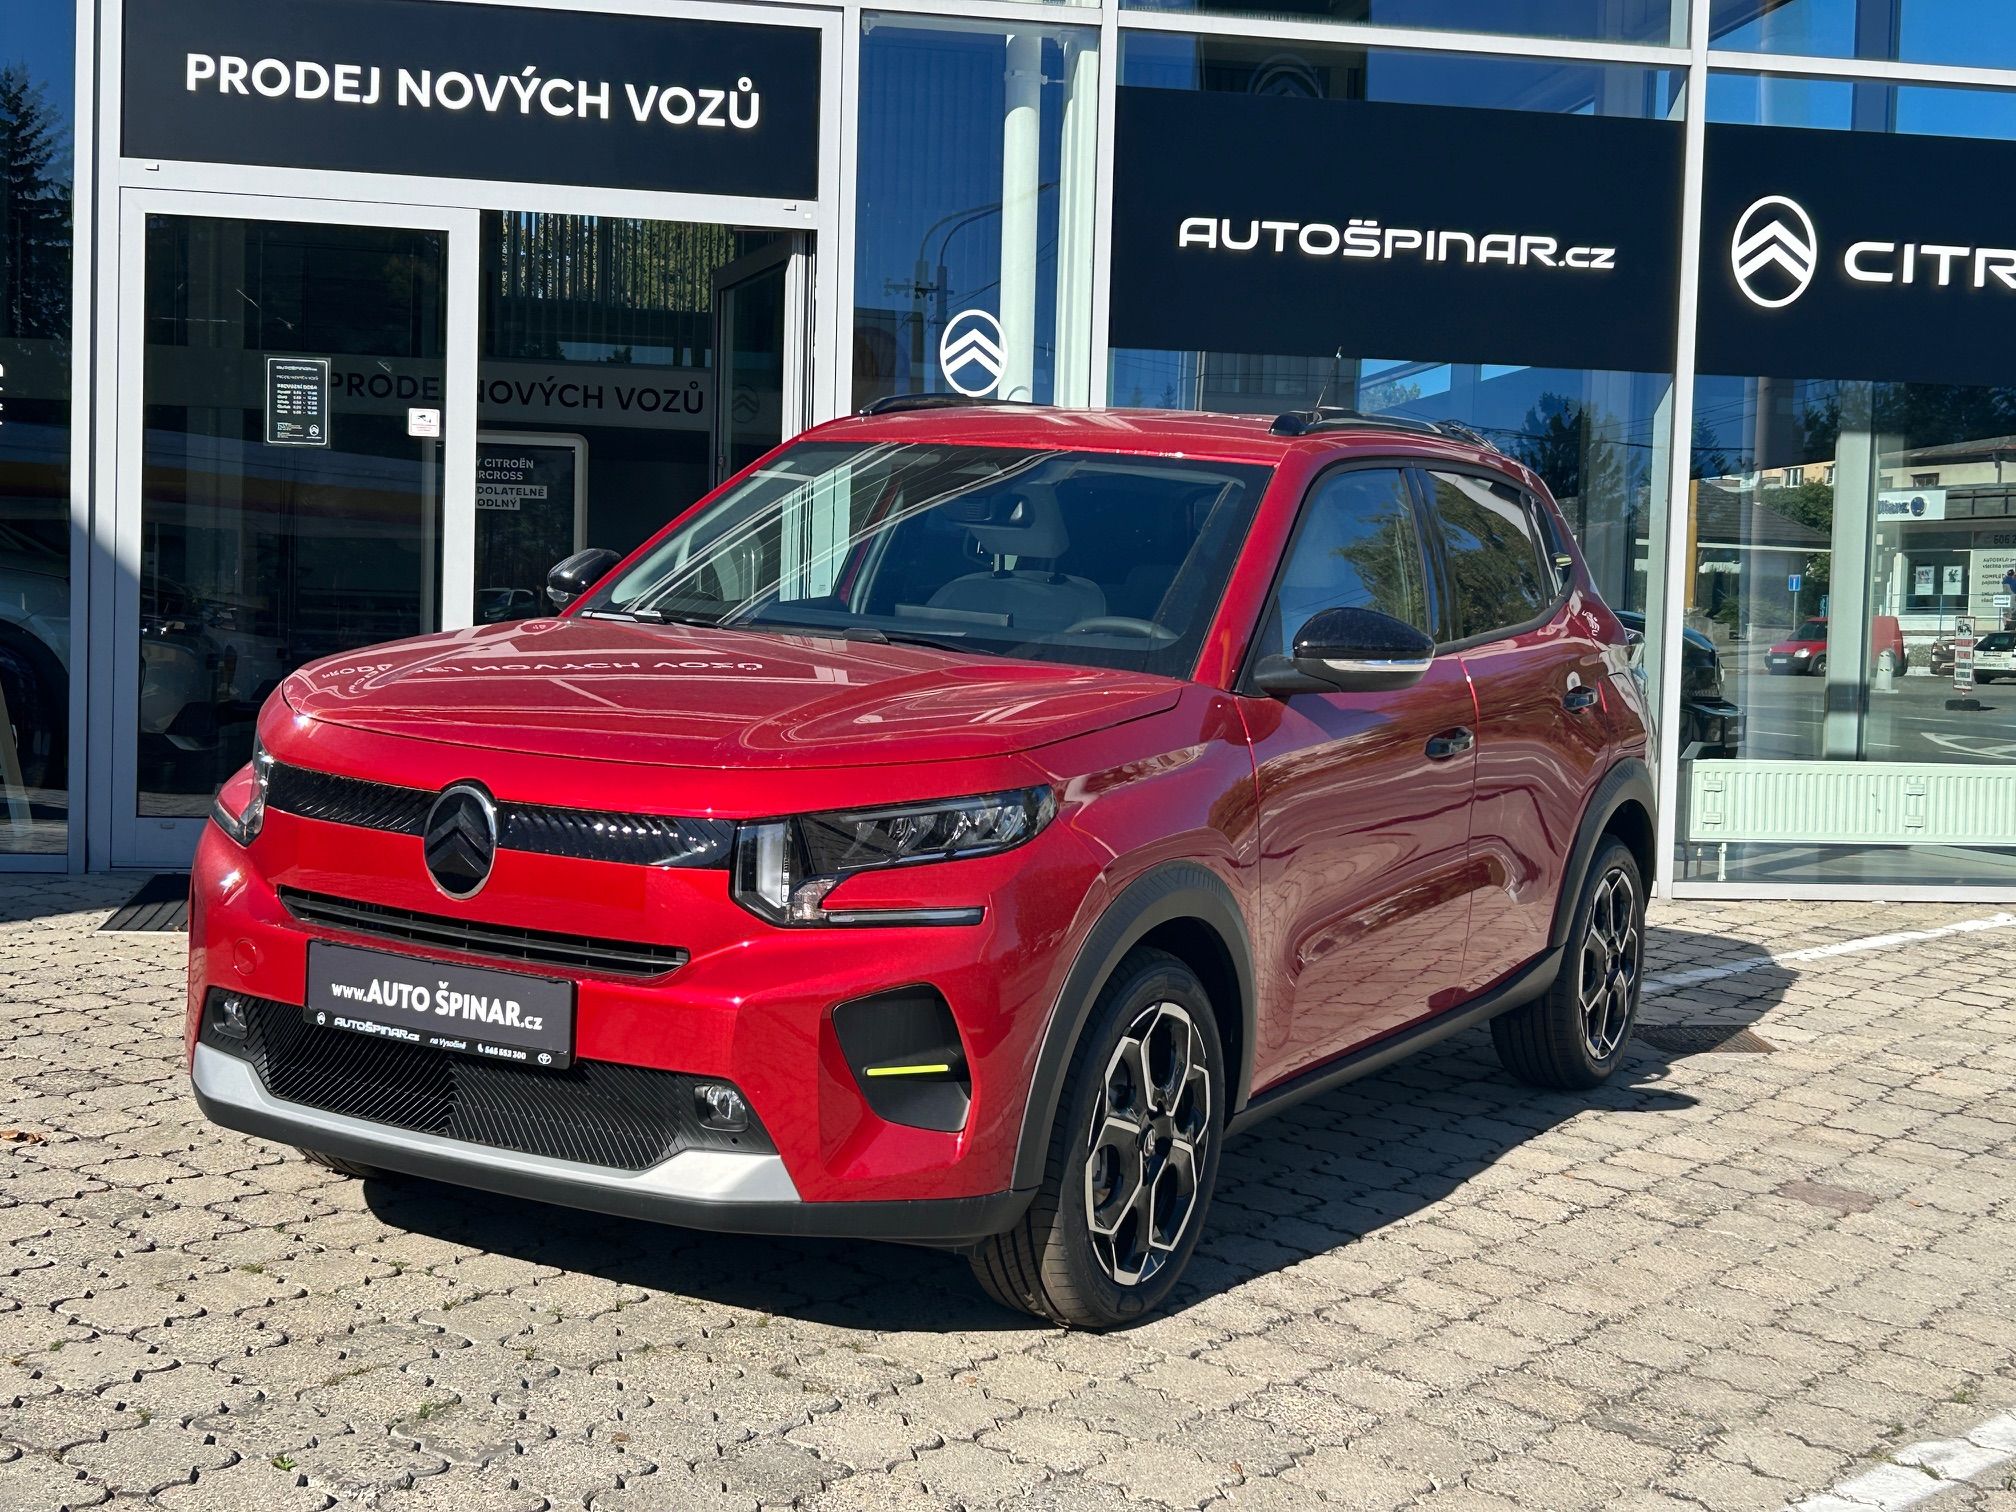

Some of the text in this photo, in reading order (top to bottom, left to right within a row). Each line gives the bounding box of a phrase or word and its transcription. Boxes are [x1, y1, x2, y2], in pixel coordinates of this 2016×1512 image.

[187, 53, 760, 130] PRODEJ NOVÝCH VOZŮ
[1178, 217, 1616, 270] AUTOŠPINAR.cz
[1844, 241, 2016, 290] CITR
[331, 372, 445, 400] PRODE
[614, 380, 704, 415] VOZŮ
[478, 470, 523, 480] RCROSS
[484, 457, 534, 469] CITROËN
[477, 486, 545, 497] DOLATELNĚ
[477, 497, 518, 508] ODLNÝ
[1877, 500, 1910, 514] llianz
[331, 978, 544, 1031] www.AUTO ŠPINAR.cz
